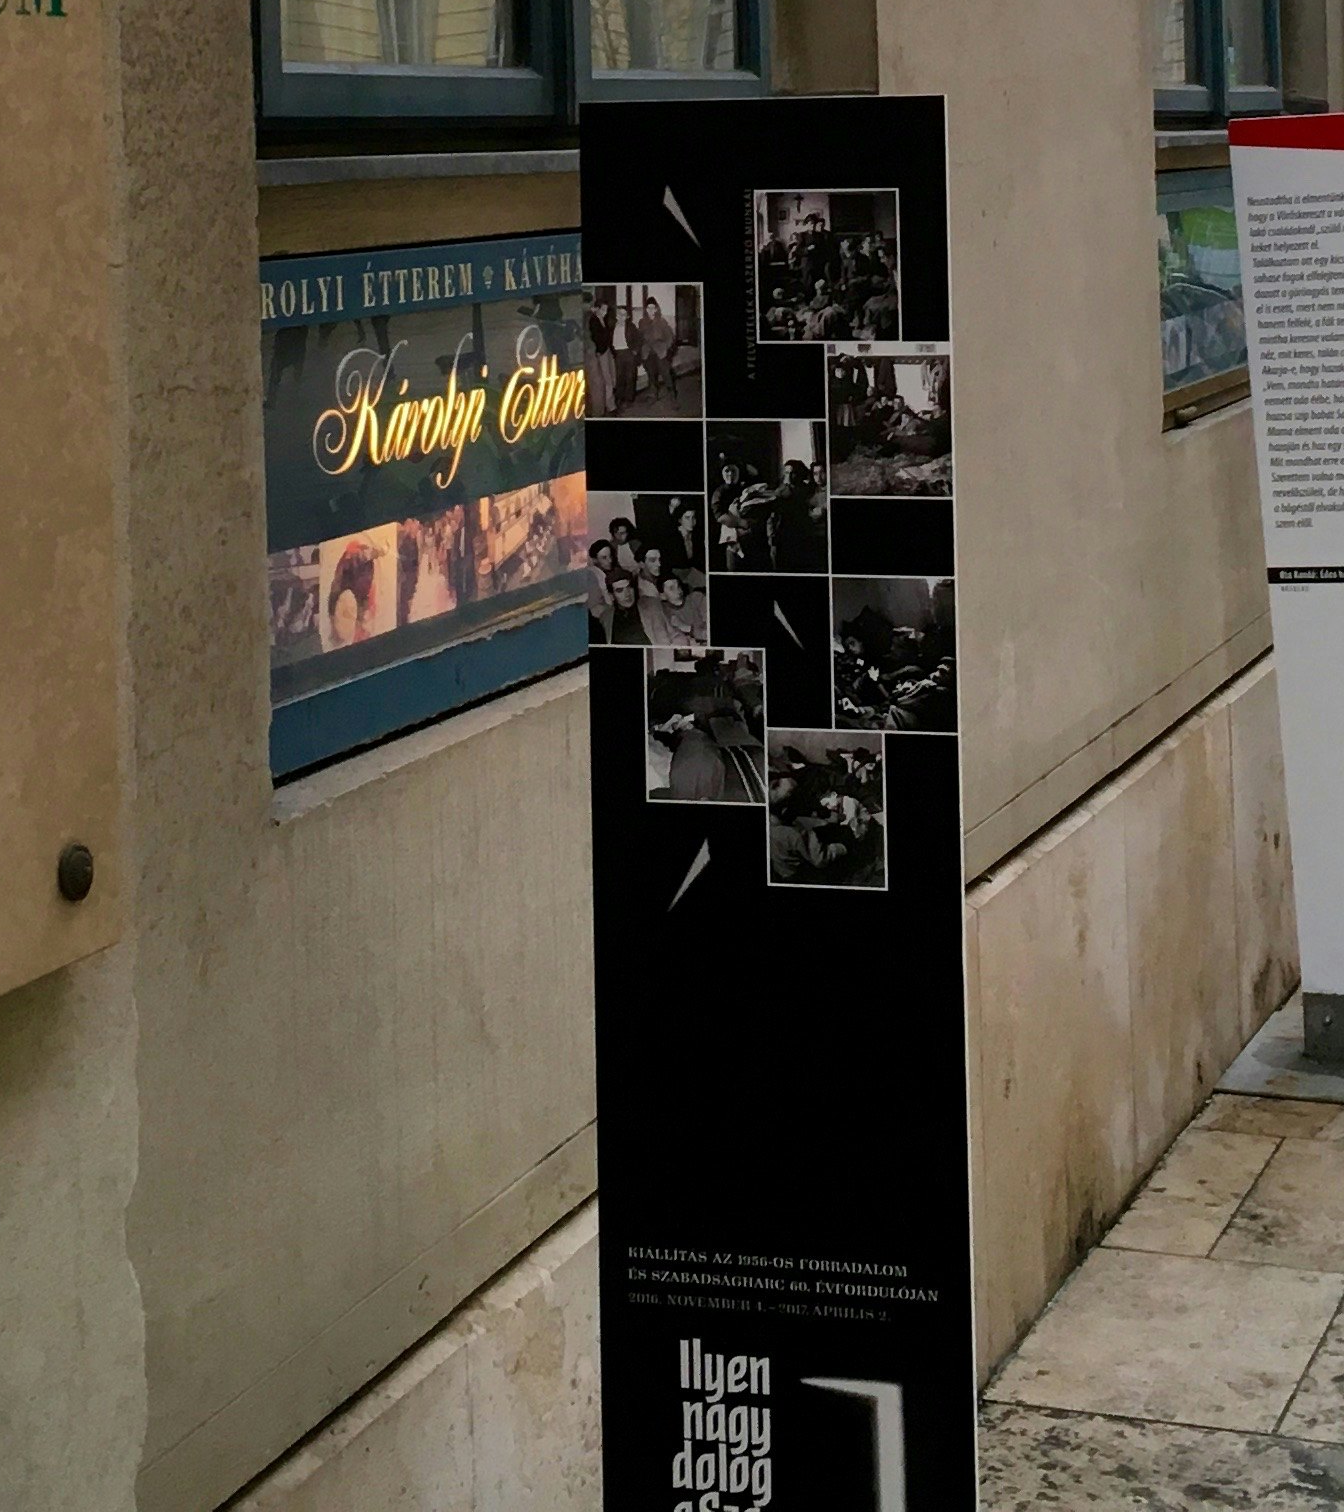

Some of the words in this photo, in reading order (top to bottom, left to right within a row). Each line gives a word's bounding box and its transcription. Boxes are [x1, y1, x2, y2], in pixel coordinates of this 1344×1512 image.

[362, 261, 473, 308] ÉTTEREM
[313, 333, 492, 489] Károlyi
[628, 1245, 708, 1263] KIÁLLÍTÁS
[713, 1252, 733, 1265] AZ
[799, 1259, 908, 1278] FORRADALOM
[628, 1265, 647, 1280] ÉS
[651, 1269, 785, 1291] SZABADSÁGHARC
[790, 1281, 811, 1293] 60.
[816, 1278, 939, 1302] ÉVFORDULÓJÁN
[667, 1294, 751, 1311] NOVEMBER
[680, 1338, 771, 1403] Ilyen
[682, 1401, 771, 1457] nagy
[672, 1439, 772, 1508] dolog
